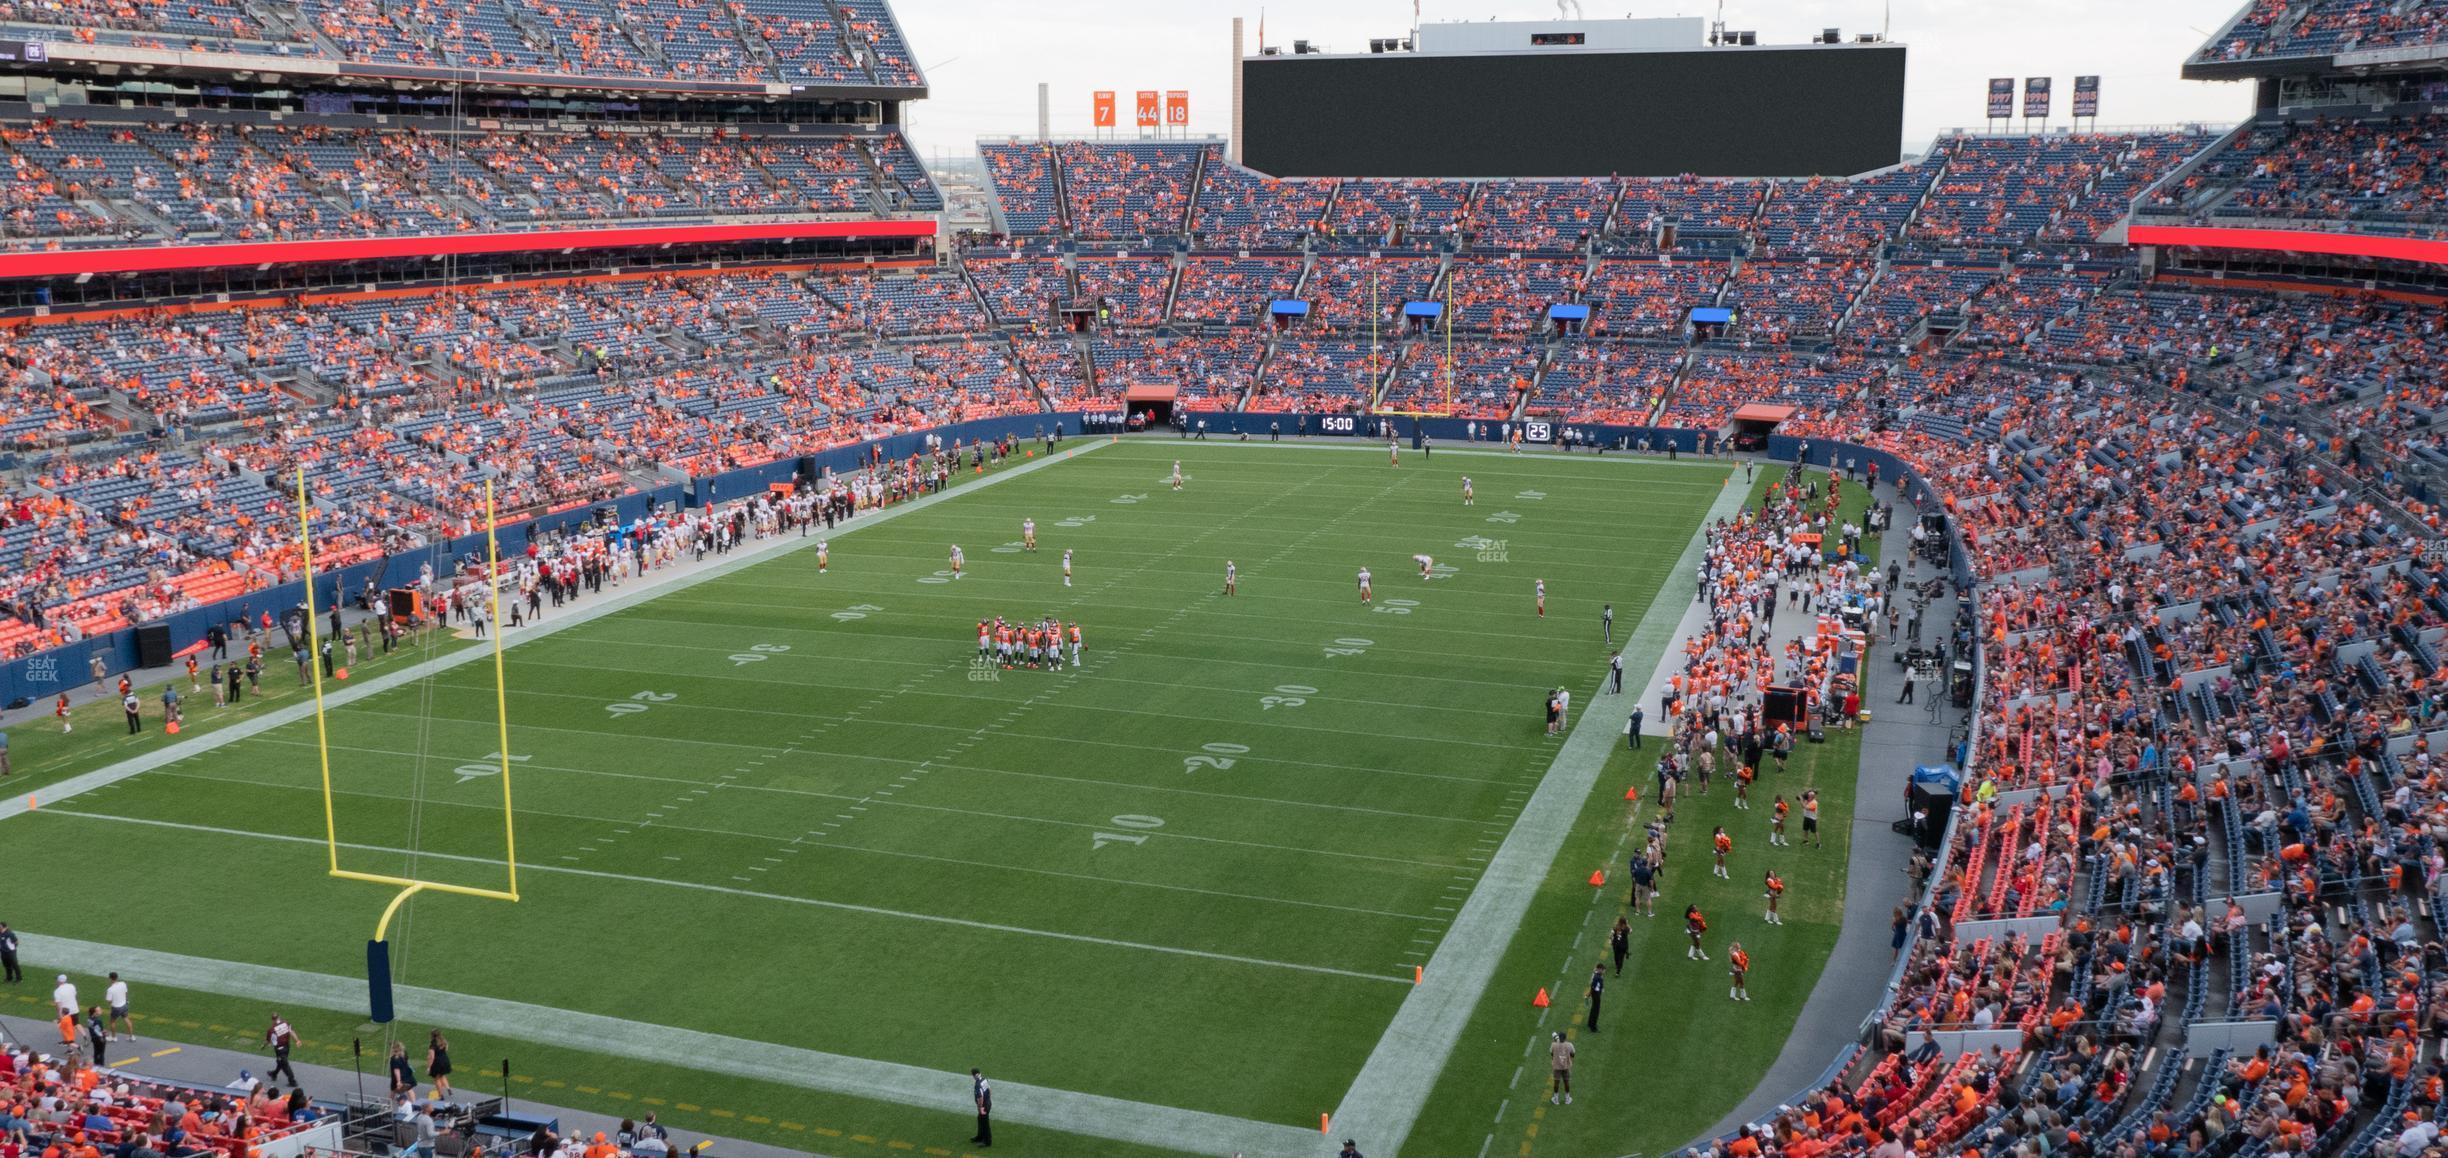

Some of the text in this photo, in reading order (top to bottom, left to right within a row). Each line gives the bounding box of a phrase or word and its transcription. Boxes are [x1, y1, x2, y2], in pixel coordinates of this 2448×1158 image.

[1989, 92, 2012, 103] 1997
[1100, 106, 1110, 122] 7
[1137, 106, 1158, 121] 44
[1169, 106, 1185, 121] 18
[1322, 418, 1353, 430] 15:00
[1530, 425, 1547, 438] 25
[830, 604, 885, 619] 40
[1372, 599, 1420, 614] 50
[728, 644, 791, 662] 30
[1323, 638, 1375, 656] 40
[605, 691, 678, 713] 20
[1260, 685, 1318, 707] 30
[454, 752, 533, 776] 10
[1184, 743, 1250, 770] 20
[1093, 814, 1165, 847] 10
